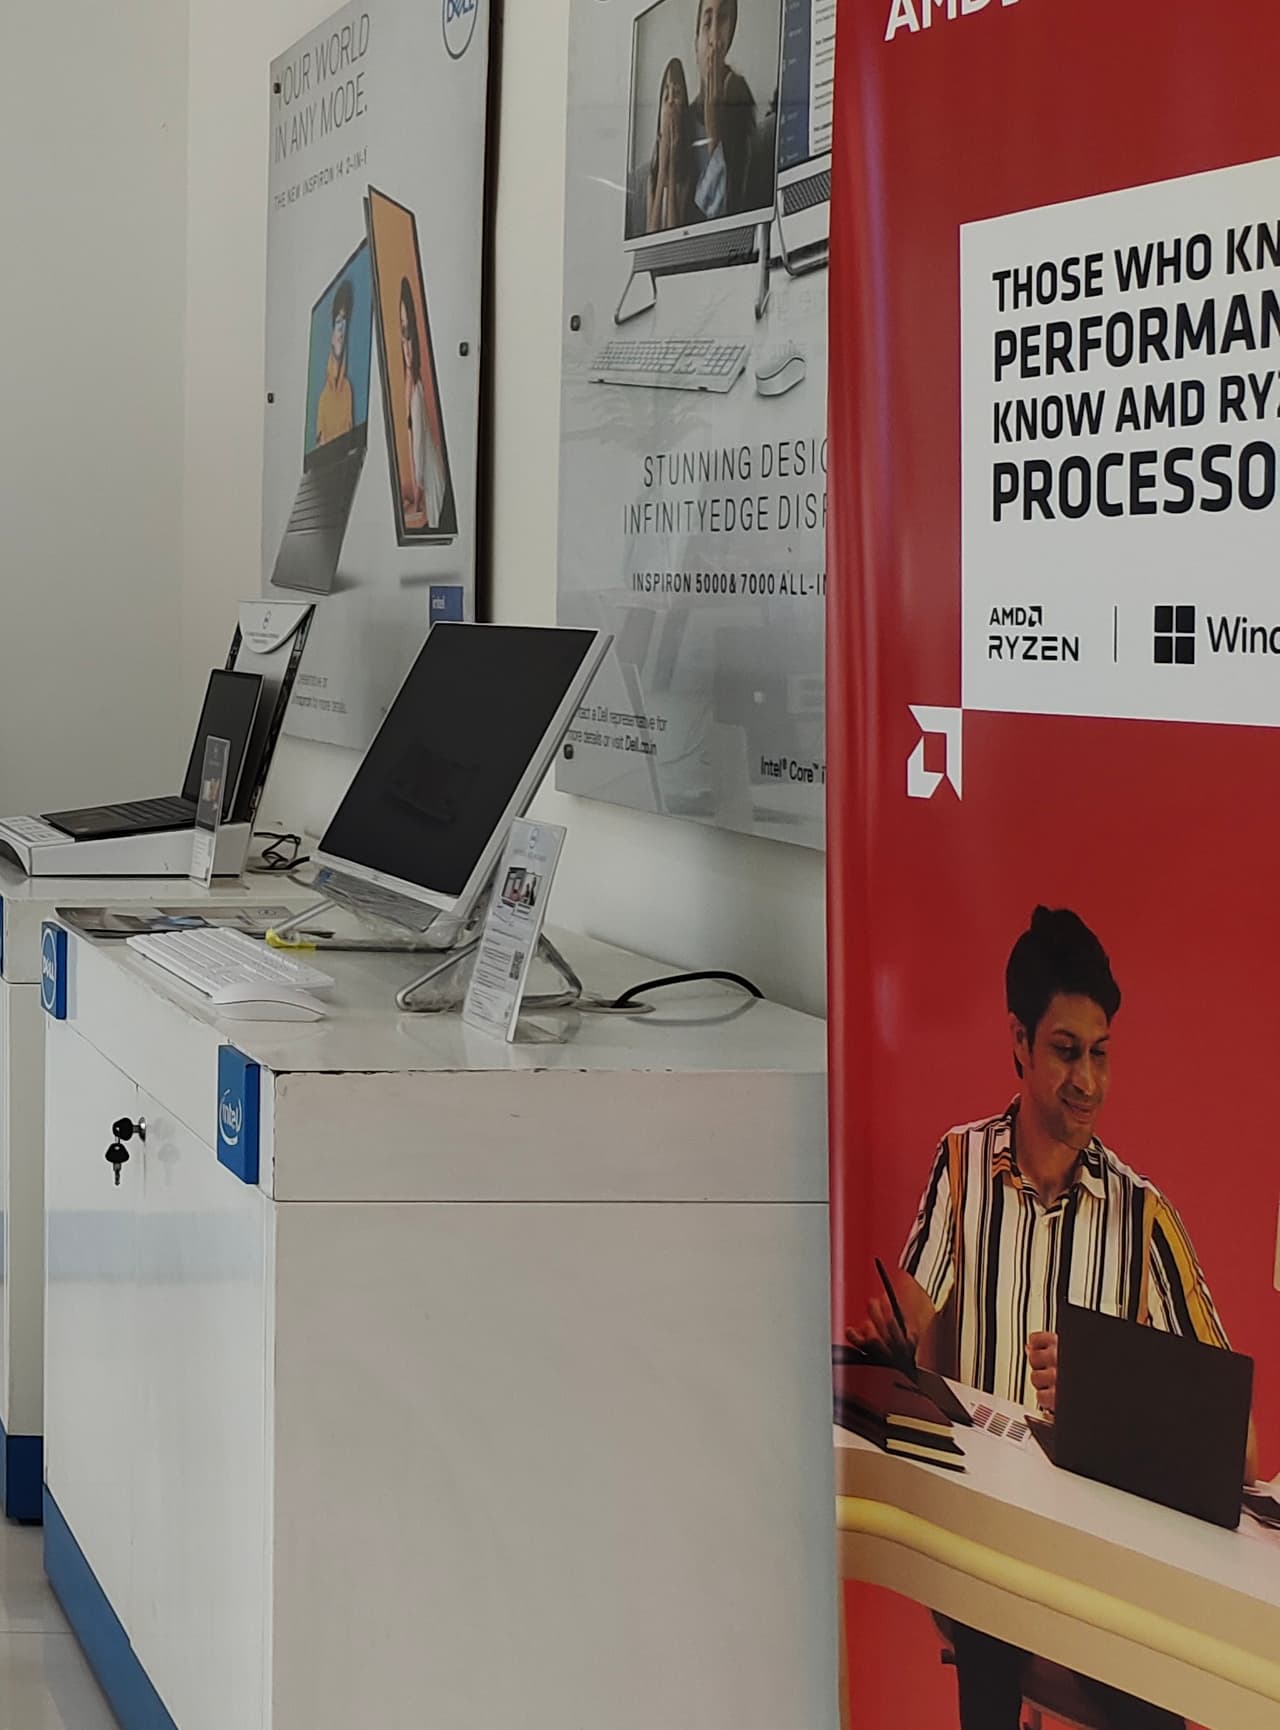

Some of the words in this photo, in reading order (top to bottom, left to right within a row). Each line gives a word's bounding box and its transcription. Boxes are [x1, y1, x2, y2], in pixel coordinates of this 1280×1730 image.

[276, 53, 311, 111] YOUR
[315, 13, 370, 84] WORLD
[274, 121, 287, 164] IN
[290, 101, 318, 152] ANY
[320, 71, 368, 137] MODE.
[992, 252, 1104, 312] THOSE
[1114, 233, 1212, 293] WHO
[993, 390, 1106, 444] KNOW
[1115, 380, 1205, 433] AMD
[1219, 371, 1280, 424] RY
[643, 446, 752, 487] STUNNING
[993, 441, 1276, 522] PROCESSO
[624, 496, 769, 535] INFINITYEDGE
[632, 572, 691, 593] INSPIRON
[740, 573, 775, 594] 7000
[989, 606, 1027, 627] AMD
[988, 635, 1080, 662] RYZEN
